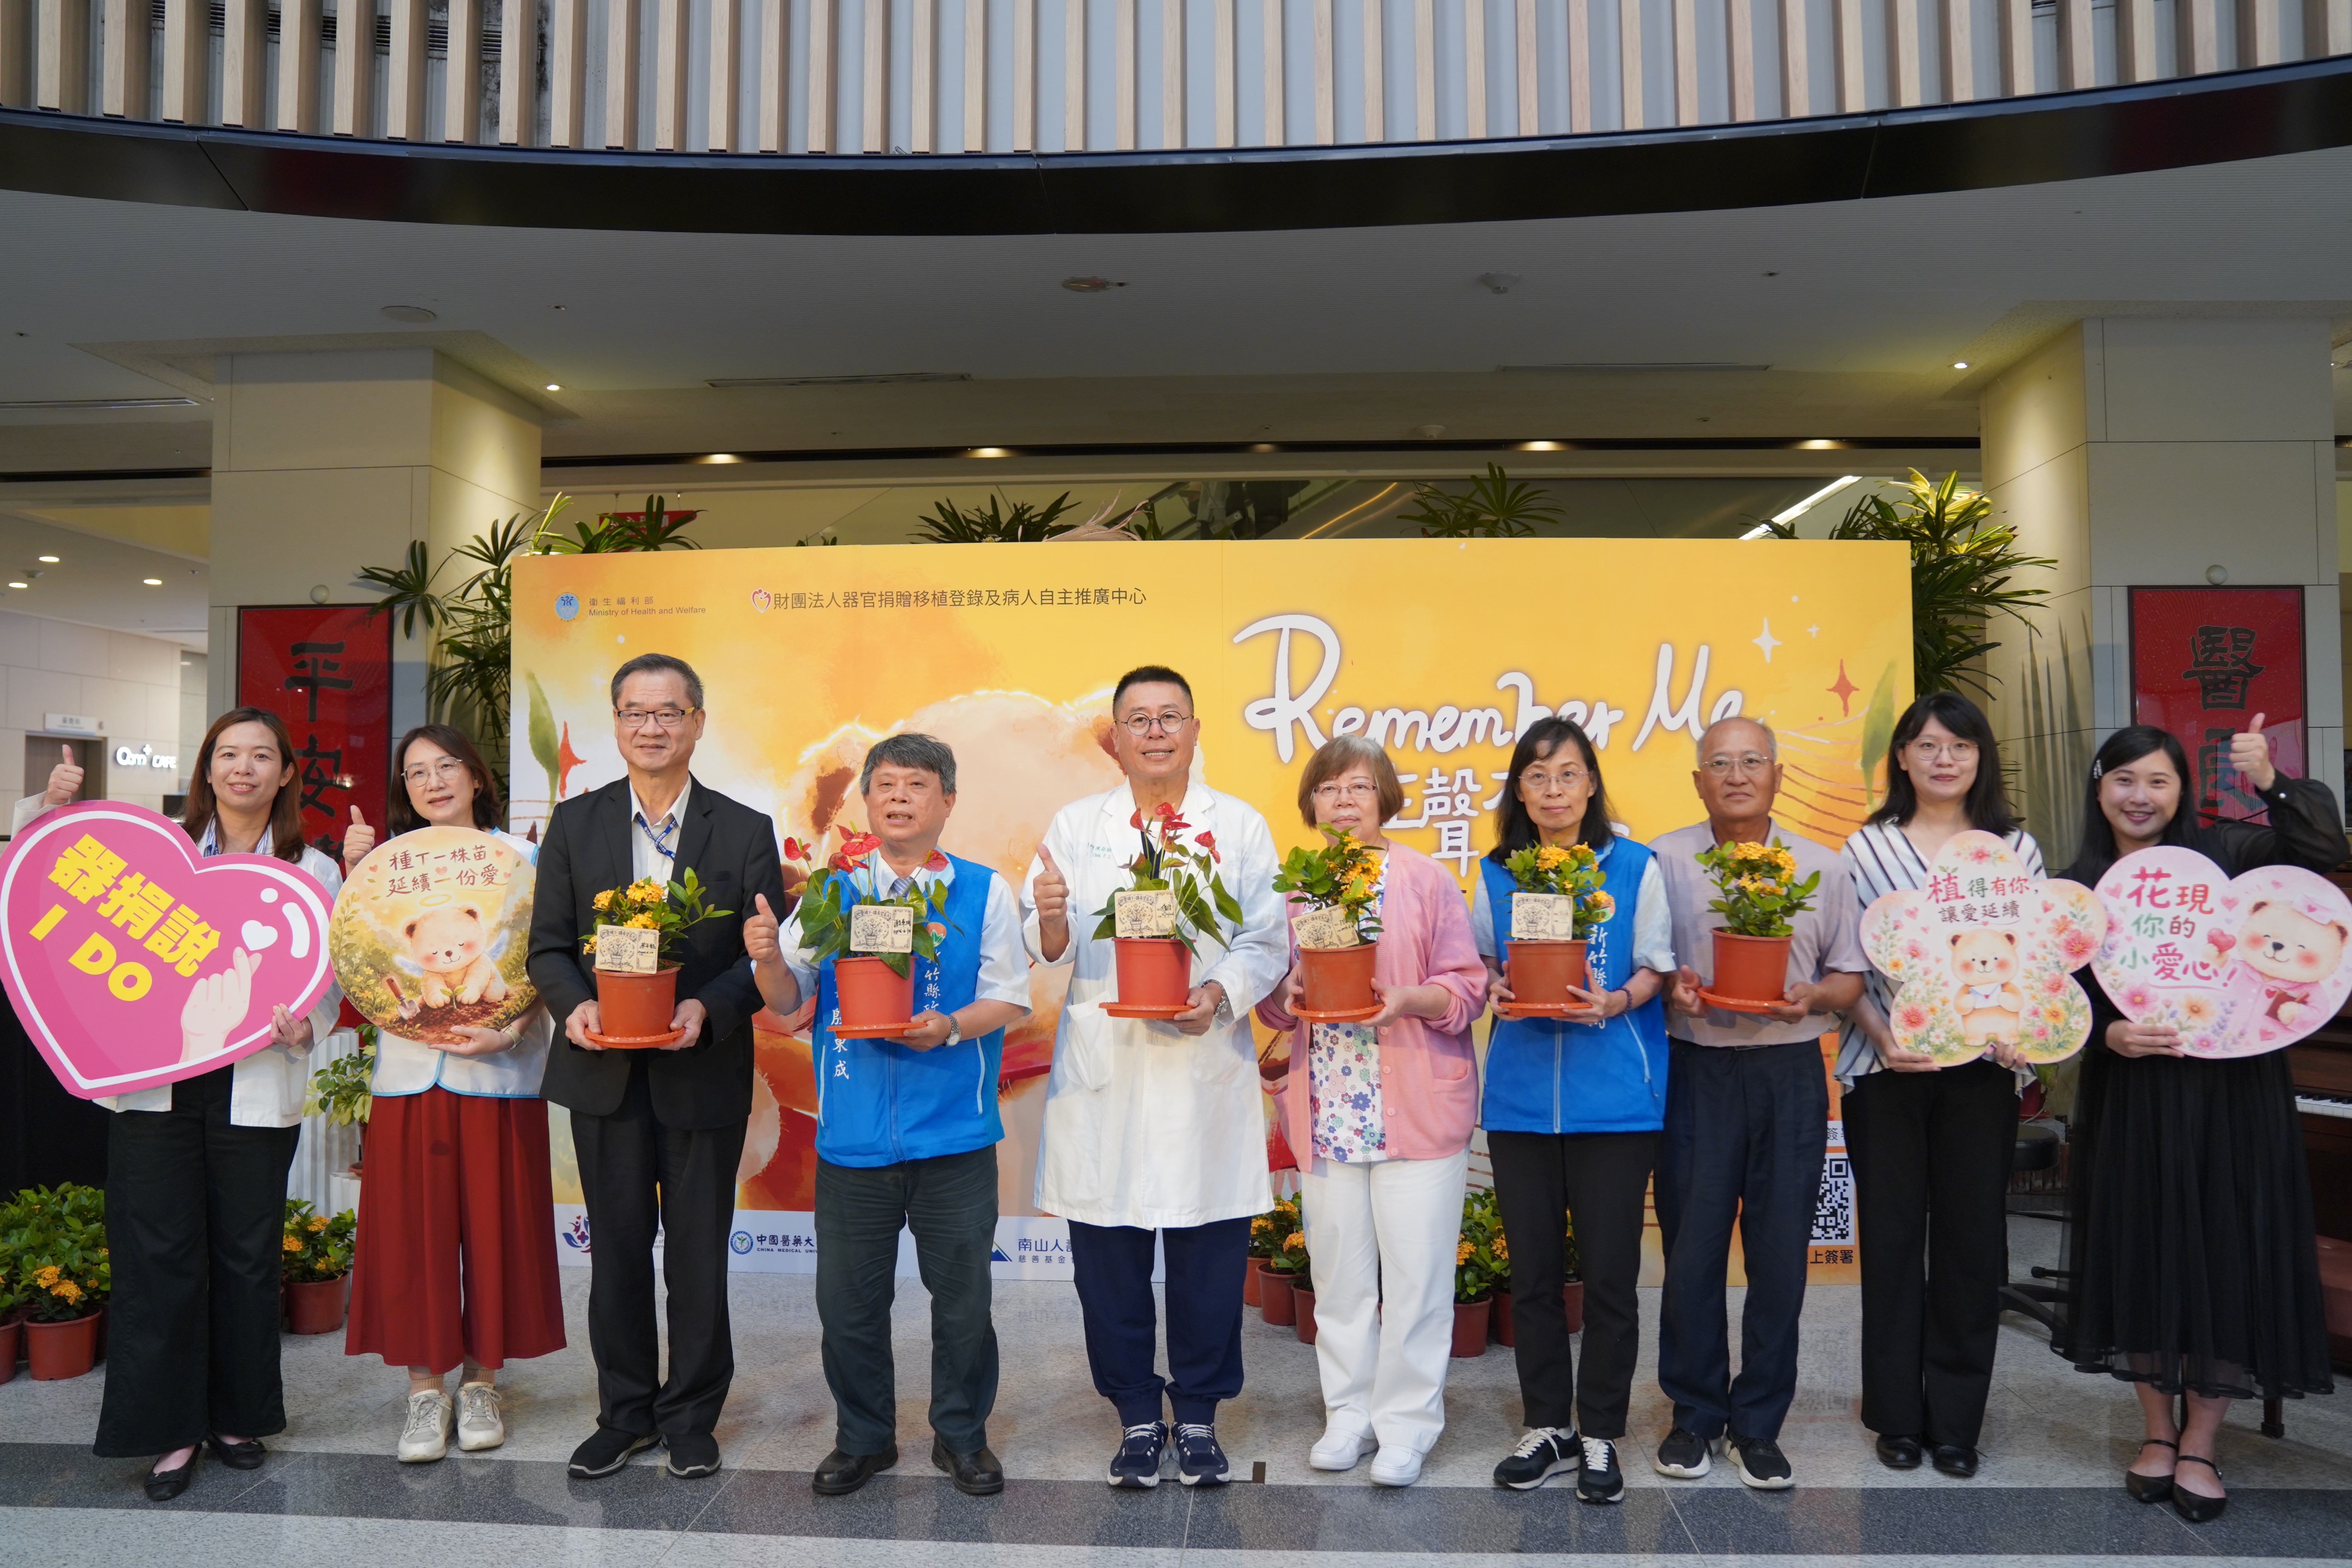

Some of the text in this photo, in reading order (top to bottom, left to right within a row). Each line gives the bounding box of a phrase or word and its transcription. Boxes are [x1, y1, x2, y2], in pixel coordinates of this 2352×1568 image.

[589, 596, 653, 606] 衛生福利部
[774, 587, 1146, 610] 財團法人器官捐贈移植登錄及病人自主推廣中心
[1234, 614, 1623, 764] Remember
[152, 755, 177, 769] CAFE
[389, 845, 487, 871] 種下一株苗
[386, 864, 509, 897] 延續一份愛
[2126, 867, 2214, 914] 花現
[1938, 900, 2020, 923] 讓愛延續
[2132, 914, 2195, 939] 你的
[29, 904, 152, 1001] I DO
[757, 1234, 815, 1247] 中國醫藥大
[1018, 1255, 1074, 1264] 慈善基金
[1807, 1250, 1853, 1264] 上簽署
